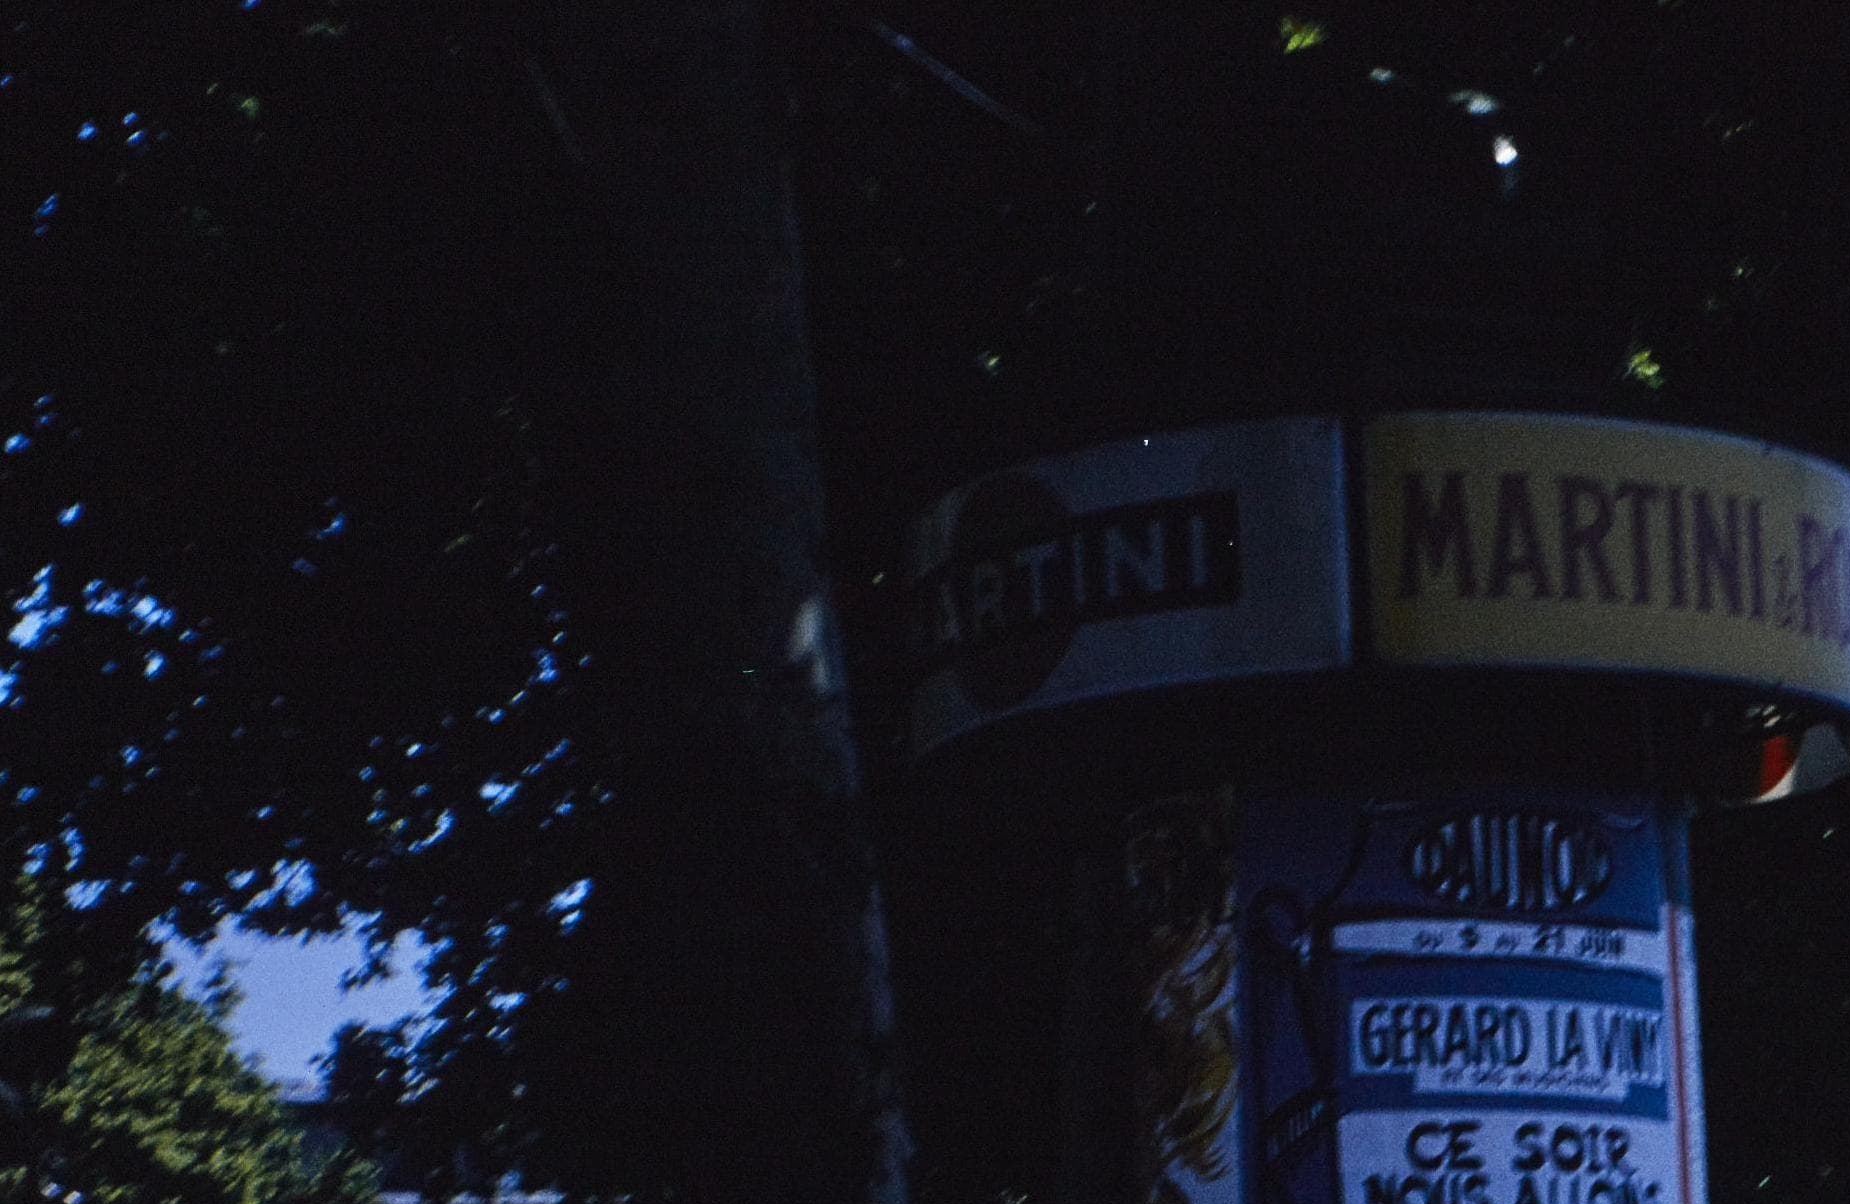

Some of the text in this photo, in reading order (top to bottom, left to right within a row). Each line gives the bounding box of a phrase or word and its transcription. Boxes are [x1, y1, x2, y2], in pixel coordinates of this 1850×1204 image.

[1400, 472, 1764, 626] MARTINI
[1359, 1003, 1532, 1067] GERARD
[1406, 1119, 1636, 1178] CE SOIR
